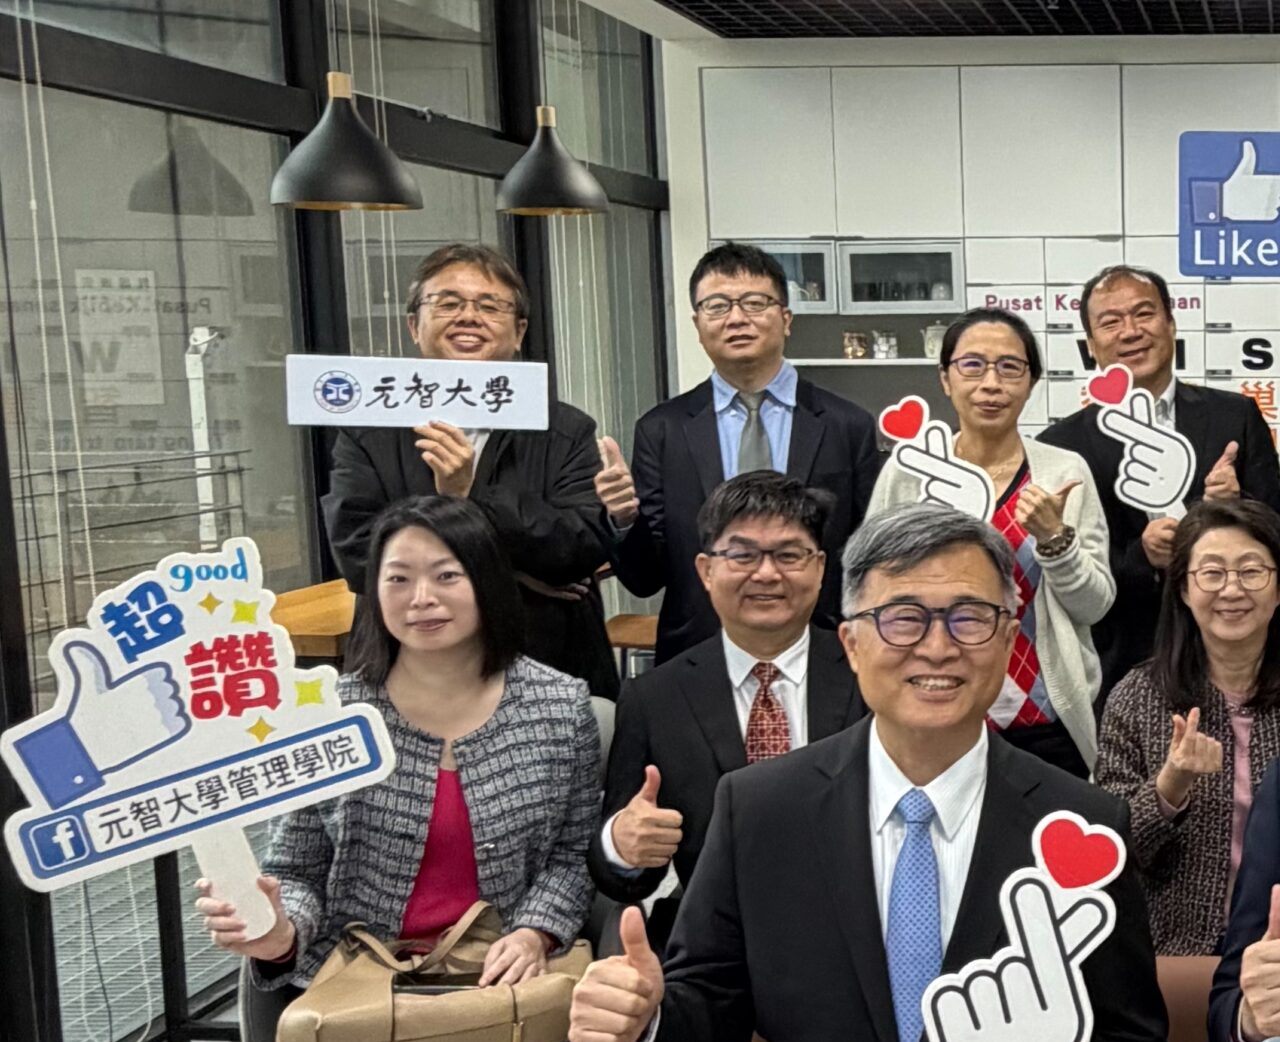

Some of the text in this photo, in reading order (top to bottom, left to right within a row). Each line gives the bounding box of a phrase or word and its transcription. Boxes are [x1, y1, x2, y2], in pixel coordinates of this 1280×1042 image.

[1194, 230, 1279, 267] Like
[985, 294, 1043, 311] Pusat
[365, 372, 515, 413] 元智大學
[170, 547, 248, 592] good
[100, 581, 187, 664] 超
[184, 631, 282, 720] 讚
[99, 734, 360, 844] 元智大學管理學院
